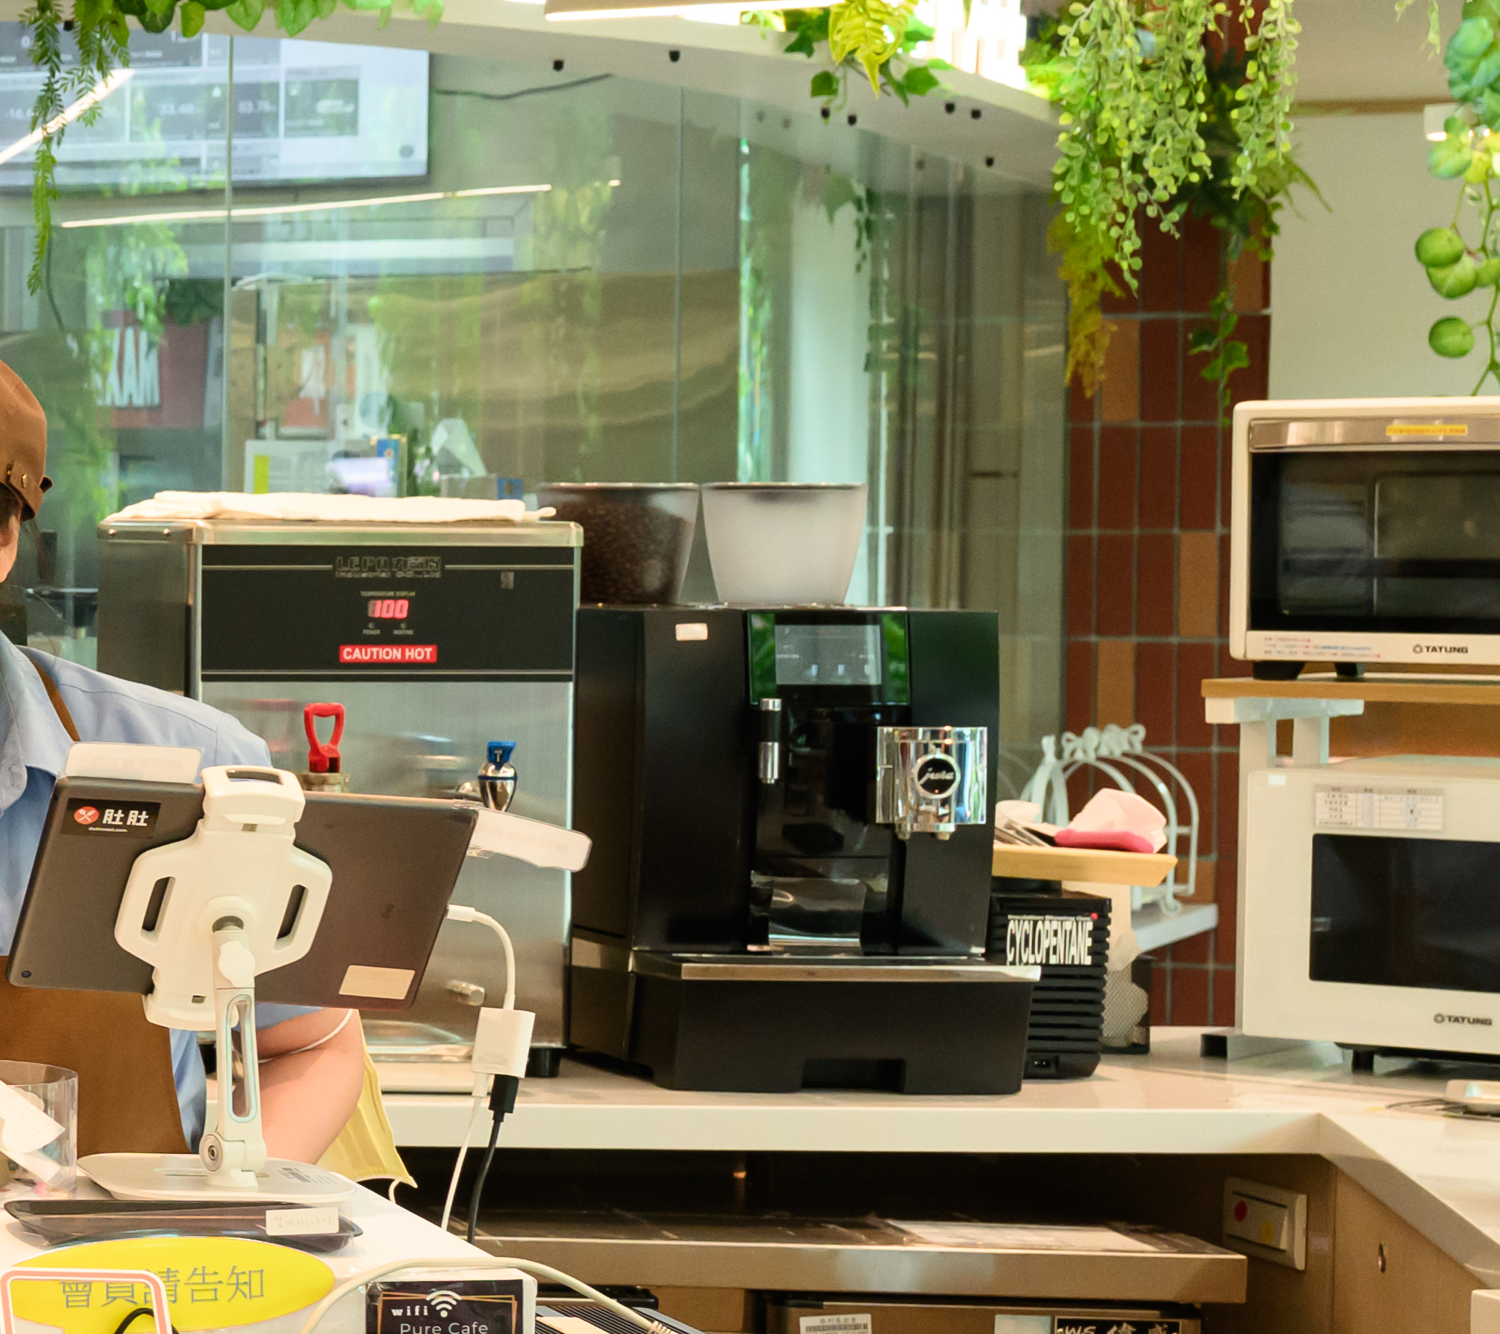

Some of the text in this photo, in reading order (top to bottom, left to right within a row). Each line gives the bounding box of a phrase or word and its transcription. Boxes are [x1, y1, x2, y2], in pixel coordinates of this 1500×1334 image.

[373, 599, 409, 619] 100
[343, 647, 433, 660] CAUTION HOT
[1425, 645, 1469, 654] TATUNG
[102, 808, 149, 827] 肚肚
[1007, 919, 1093, 965] CYCLOPENTANE
[1446, 1015, 1492, 1026] TATUNG
[391, 1305, 428, 1317] wifi
[448, 1322, 489, 1334] Cafe
